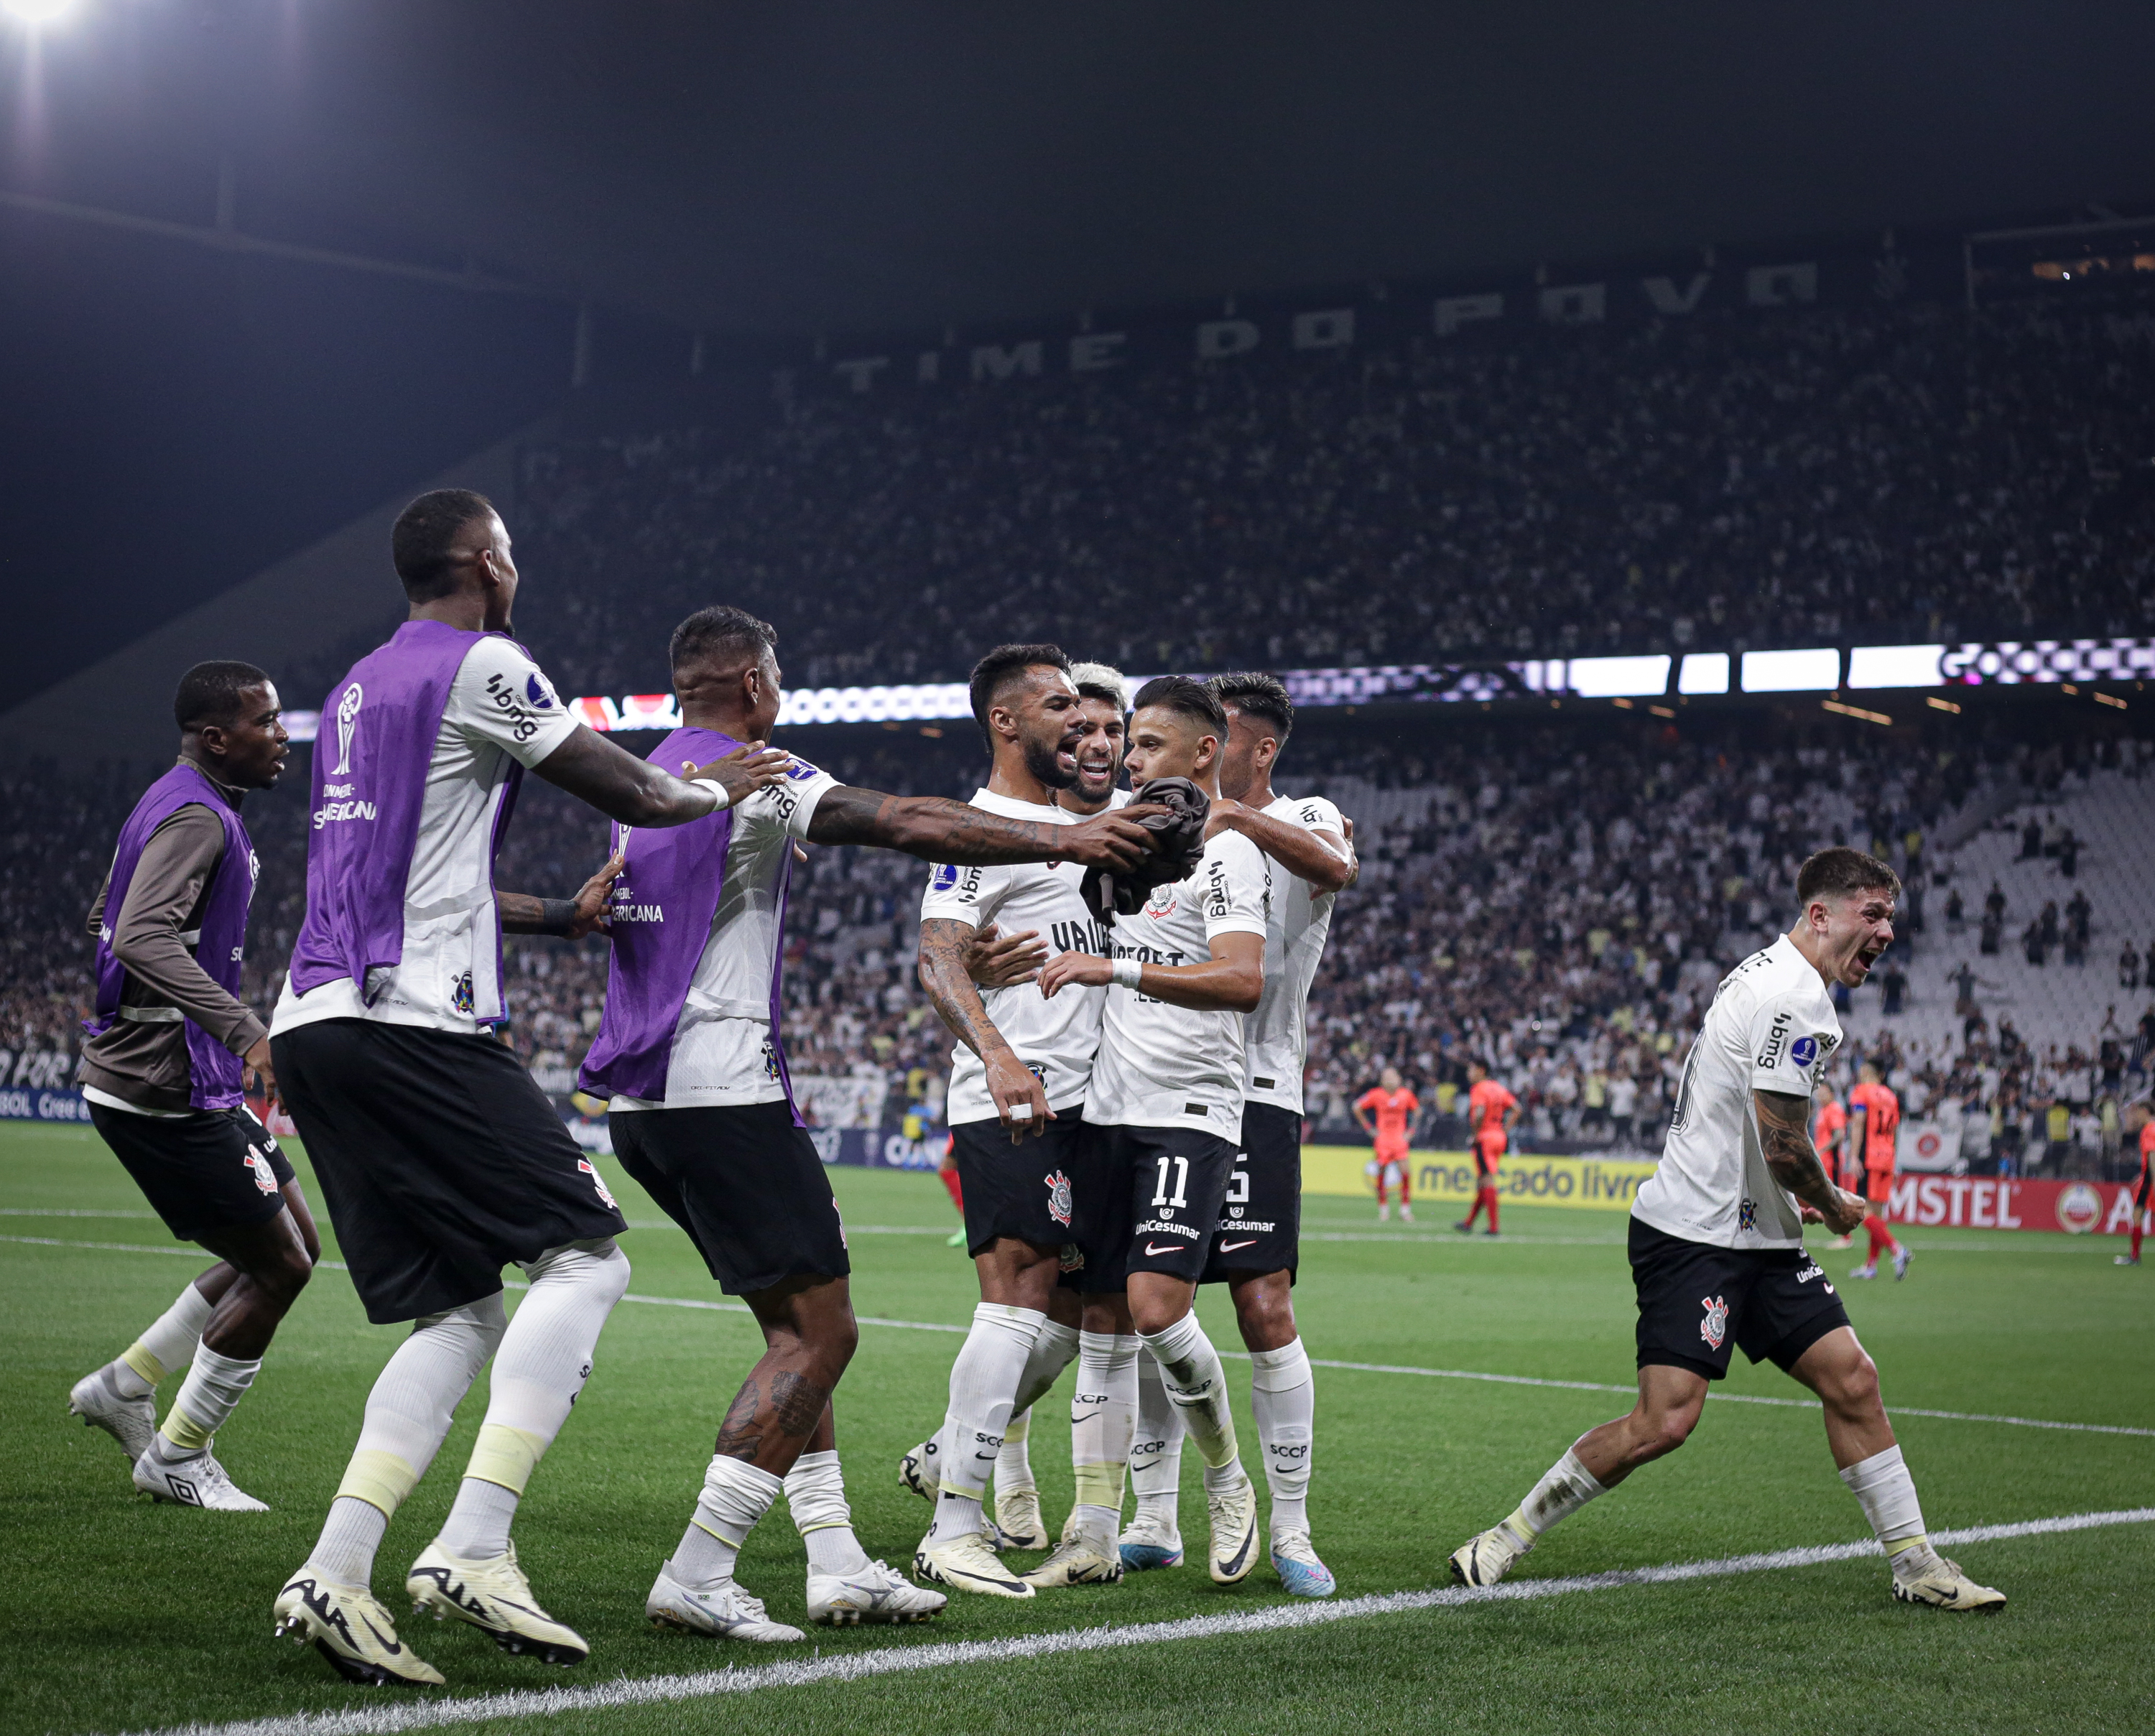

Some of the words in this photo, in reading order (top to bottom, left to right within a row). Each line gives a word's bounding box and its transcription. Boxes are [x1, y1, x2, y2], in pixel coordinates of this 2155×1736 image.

[833, 330, 1126, 394] TIME
[1197, 309, 1355, 359] DO
[1435, 262, 1818, 337] POVO
[492, 687, 538, 742] bmg
[782, 783, 799, 799] NTHIANS
[1210, 873, 1227, 918] bmg
[1758, 1026, 1789, 1069] bmg
[1151, 1156, 1188, 1208] 11
[1419, 1158, 1574, 1199] mecado
[1882, 1177, 2023, 1230] MSTEL
[1136, 1220, 1200, 1240] UniCesumar
[1074, 1393, 1108, 1404] CCP
[1166, 1378, 1212, 1396] SCCP
[975, 1432, 1004, 1448] SCC
[1270, 1444, 1307, 1458] SCCP
